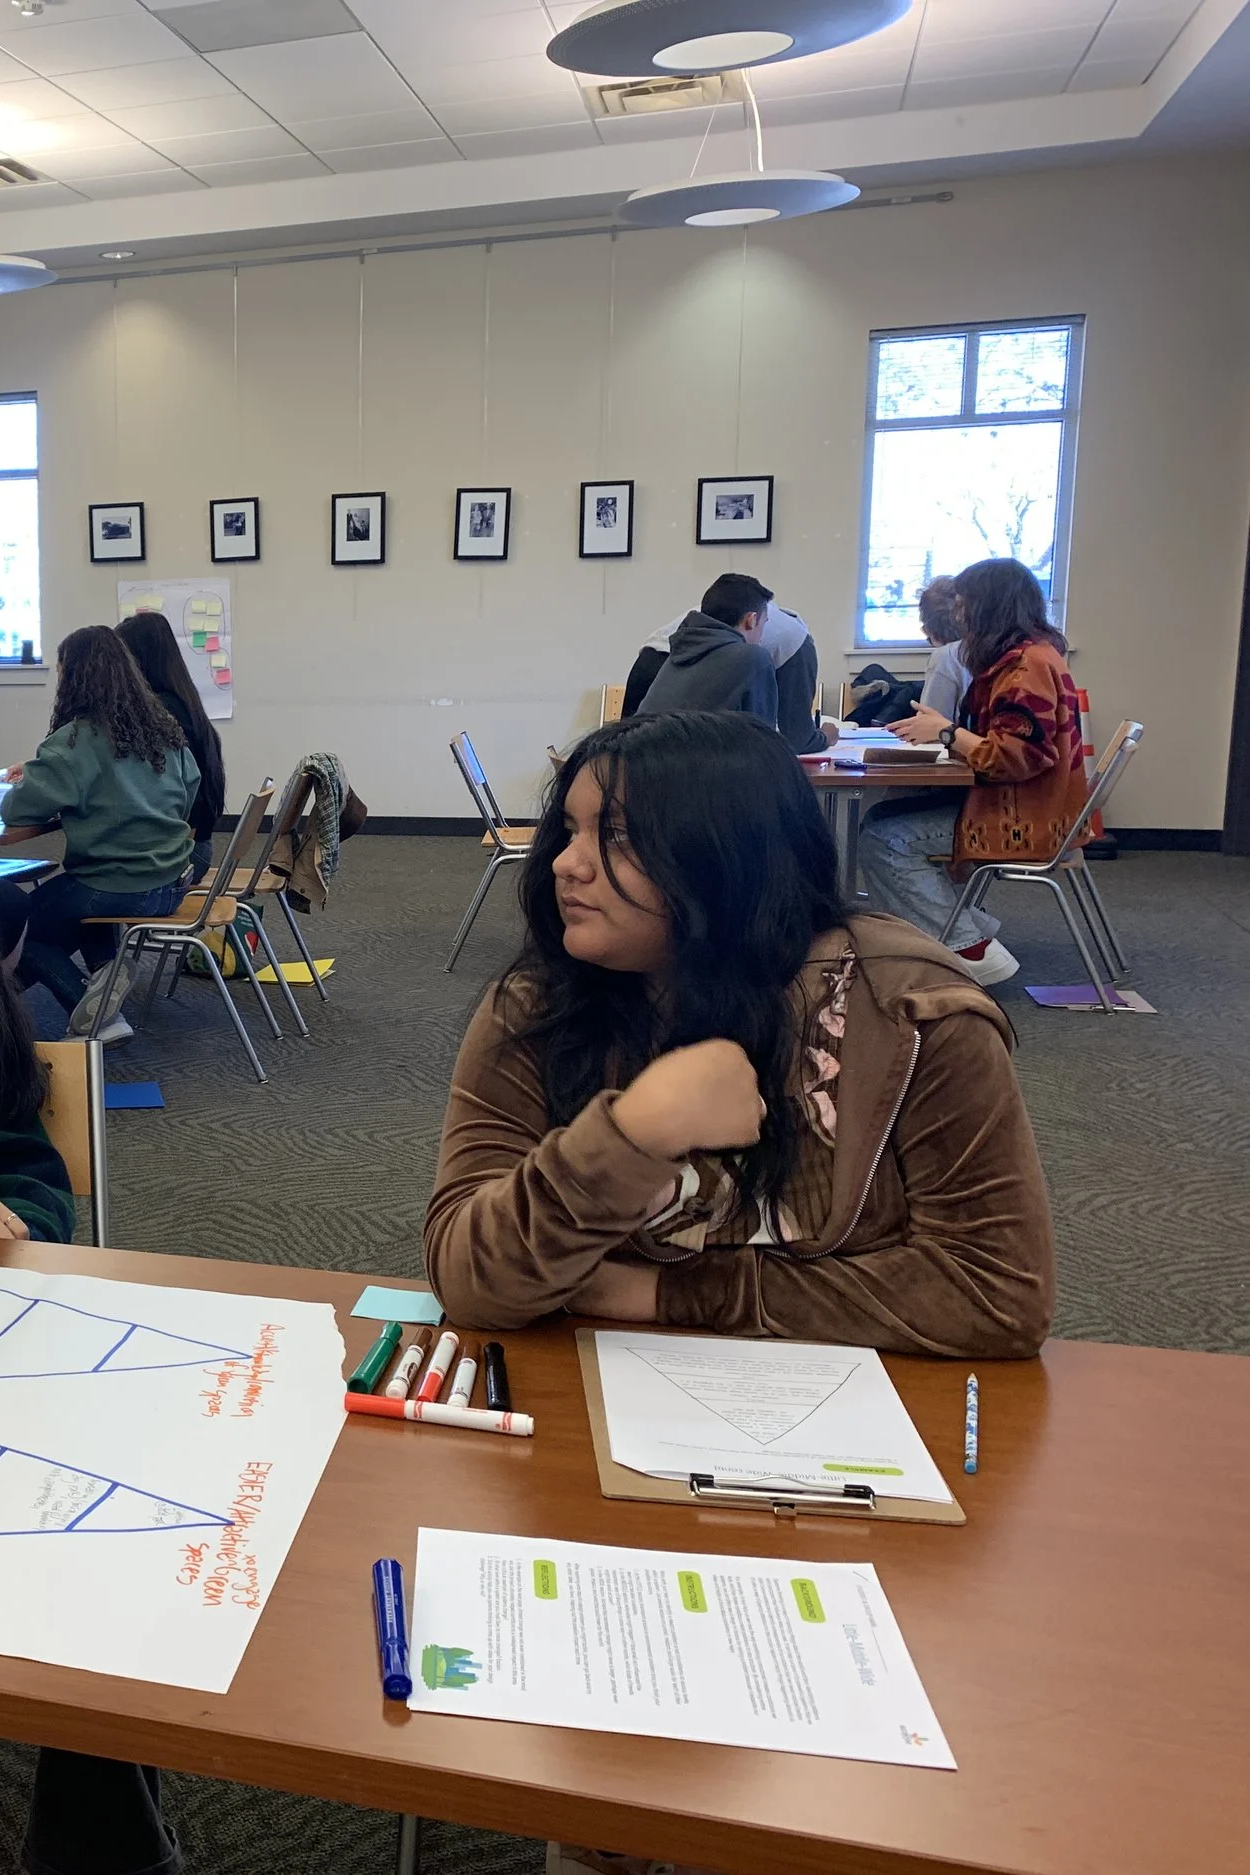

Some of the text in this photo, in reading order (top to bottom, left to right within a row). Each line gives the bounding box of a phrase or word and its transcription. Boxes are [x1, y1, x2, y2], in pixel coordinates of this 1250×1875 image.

[231, 1566, 261, 1610] engage
[540, 1564, 551, 1595] REFLECTIONS
[685, 1574, 700, 1609] INSTRUCTIONS
[799, 1582, 817, 1619] BACKGROUND
